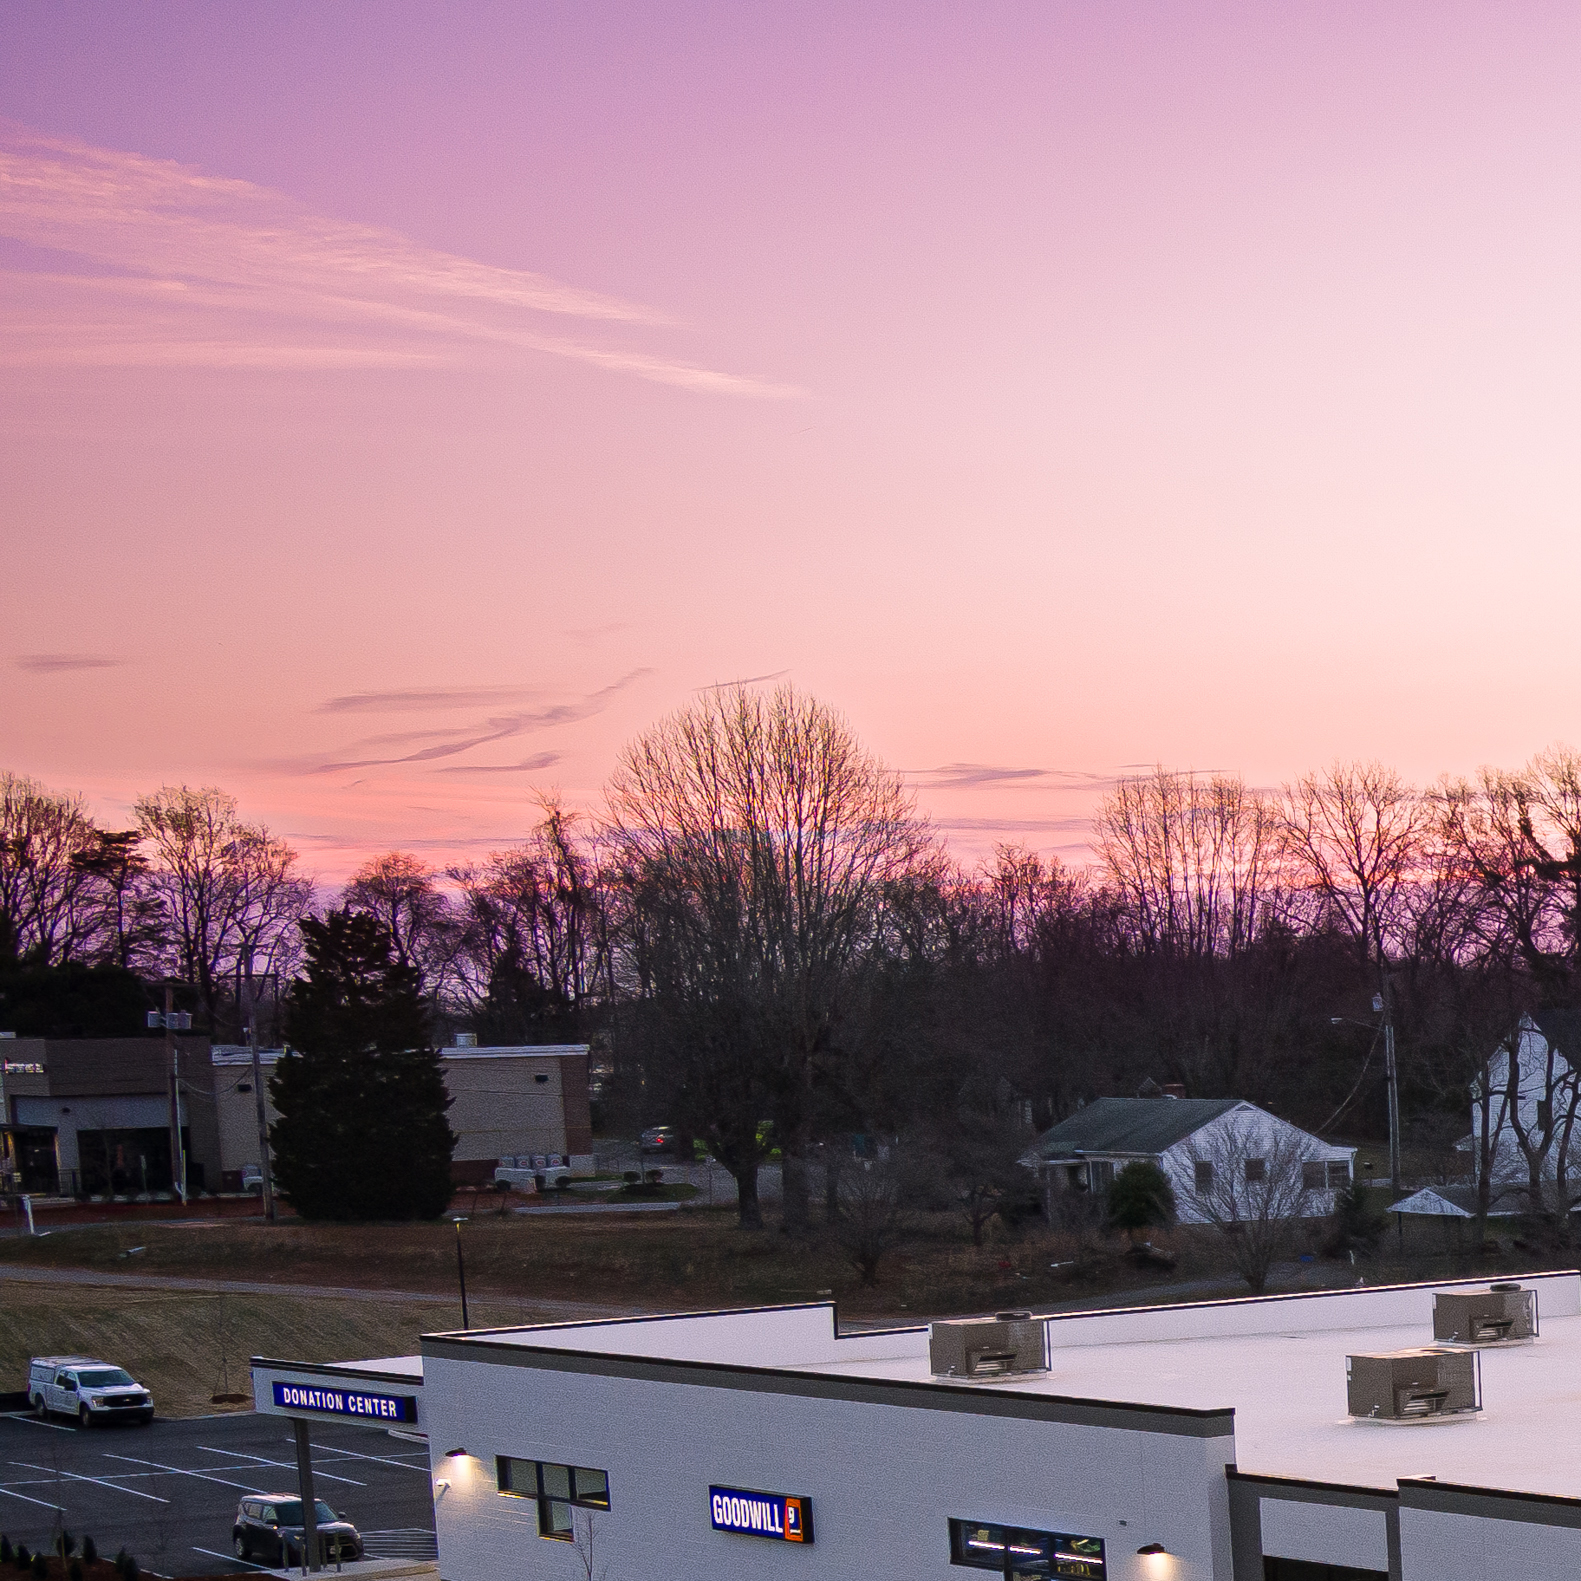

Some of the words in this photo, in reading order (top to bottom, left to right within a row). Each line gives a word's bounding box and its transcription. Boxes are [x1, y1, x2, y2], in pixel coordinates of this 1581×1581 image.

[283, 1387, 343, 1410] DONATION
[348, 1396, 397, 1417] CENTER
[713, 1495, 783, 1533] GOODWILL
